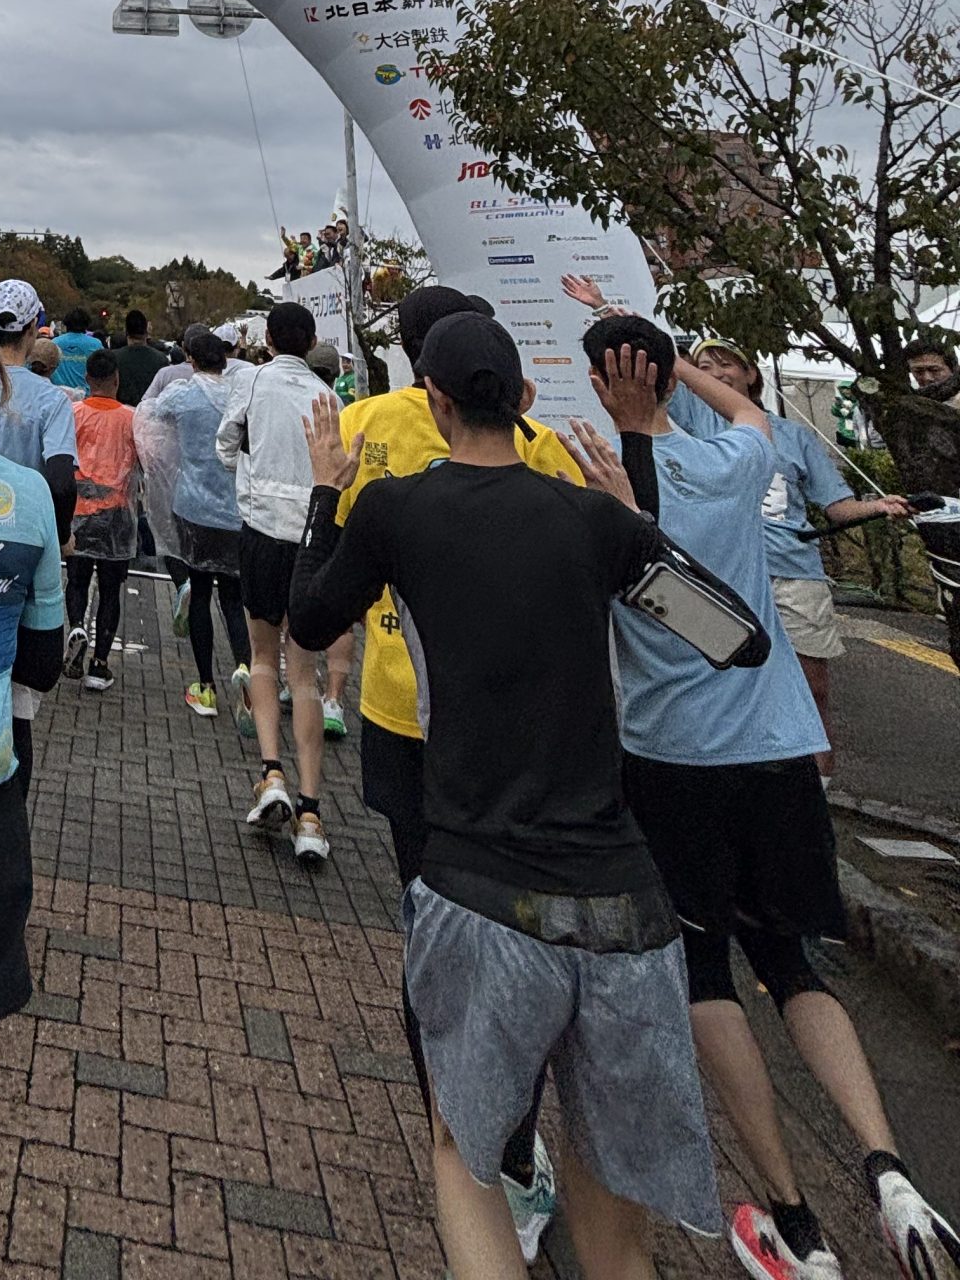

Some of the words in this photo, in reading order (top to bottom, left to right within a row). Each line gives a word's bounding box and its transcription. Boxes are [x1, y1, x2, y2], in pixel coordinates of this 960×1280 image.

[374, 27, 450, 50] 大谷製鉄
[457, 161, 490, 182] JTB
[485, 209, 565, 220] community
